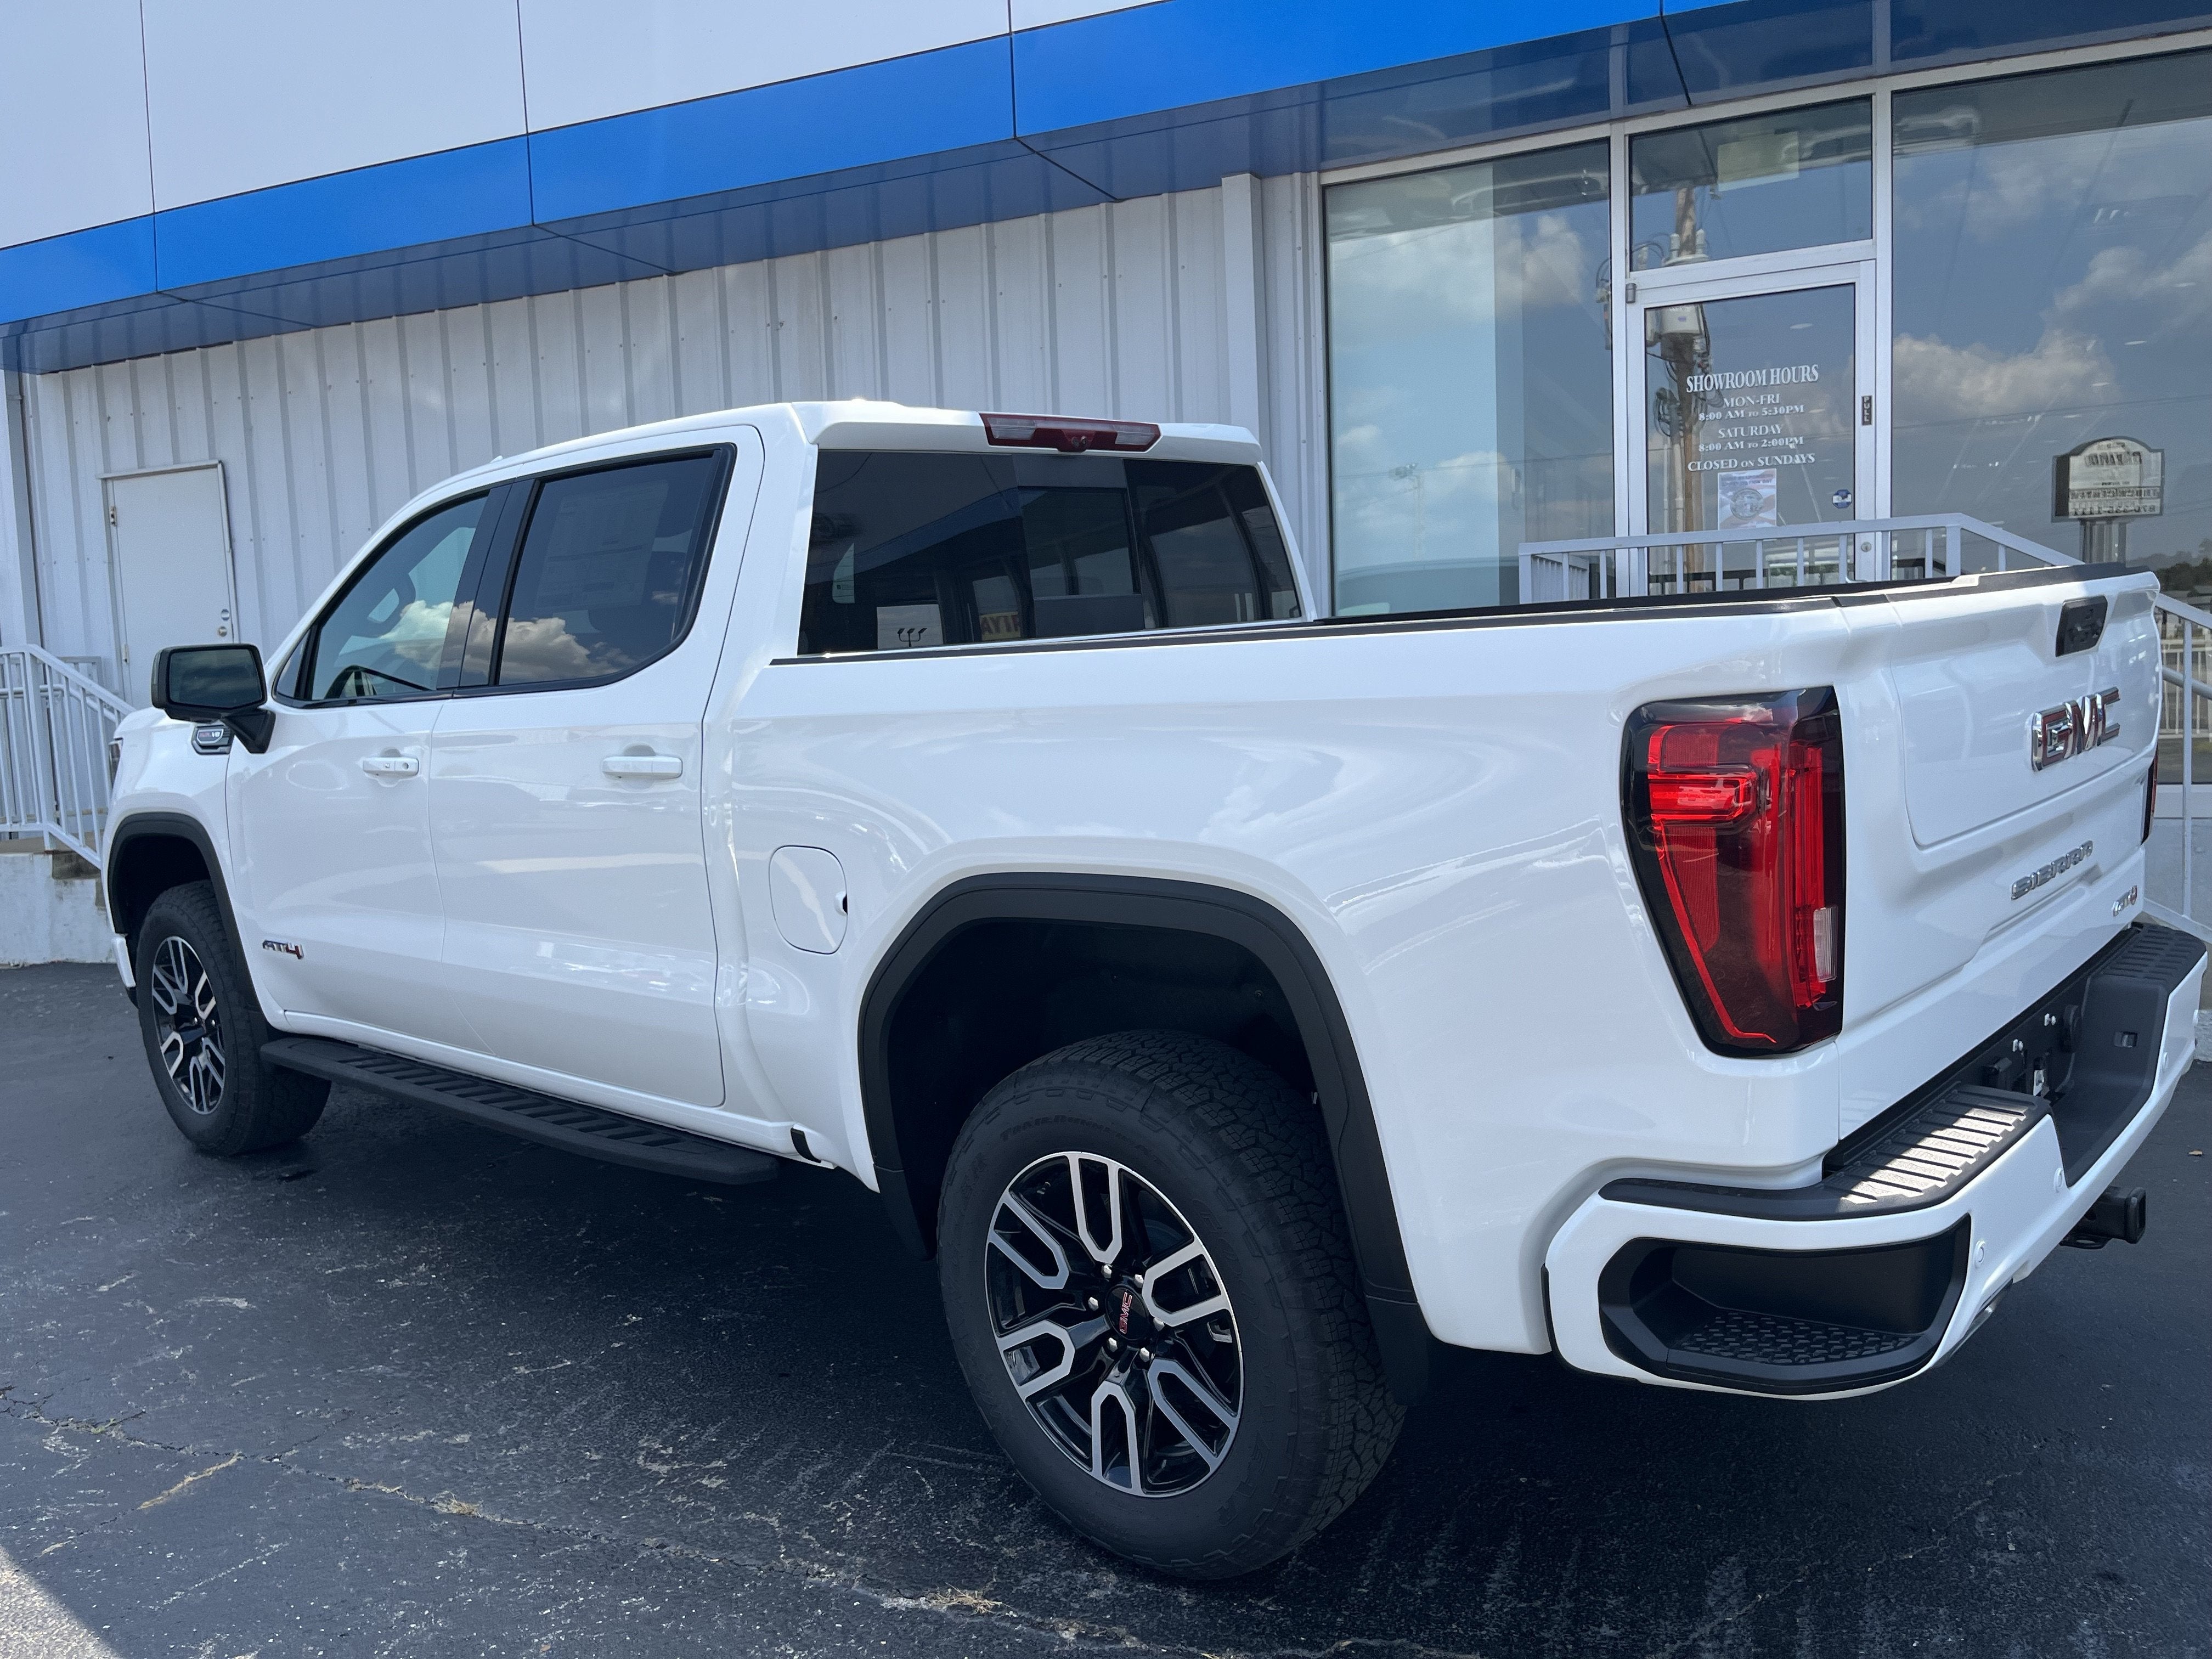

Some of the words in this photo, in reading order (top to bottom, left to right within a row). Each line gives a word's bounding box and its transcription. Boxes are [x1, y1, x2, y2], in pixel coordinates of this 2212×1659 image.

[1686, 370, 1768, 393] SHOWROOM
[1769, 364, 1819, 386] HOURS
[1723, 393, 1780, 408] MON-FRI
[1699, 411, 1722, 421] 8:00
[1724, 410, 1745, 419] AM
[1762, 404, 1804, 416] 5:30PM
[1718, 424, 1782, 439] SATURDAY
[1699, 442, 1722, 452] 8:00
[1724, 441, 1745, 450] AM
[1688, 459, 1738, 471] CLOSED
[1757, 453, 1815, 466] SUNDAYS
[2032, 686, 2121, 771] GMC
[2011, 840, 2094, 901] SIERRA
[1119, 1291, 1133, 1334] GMC
